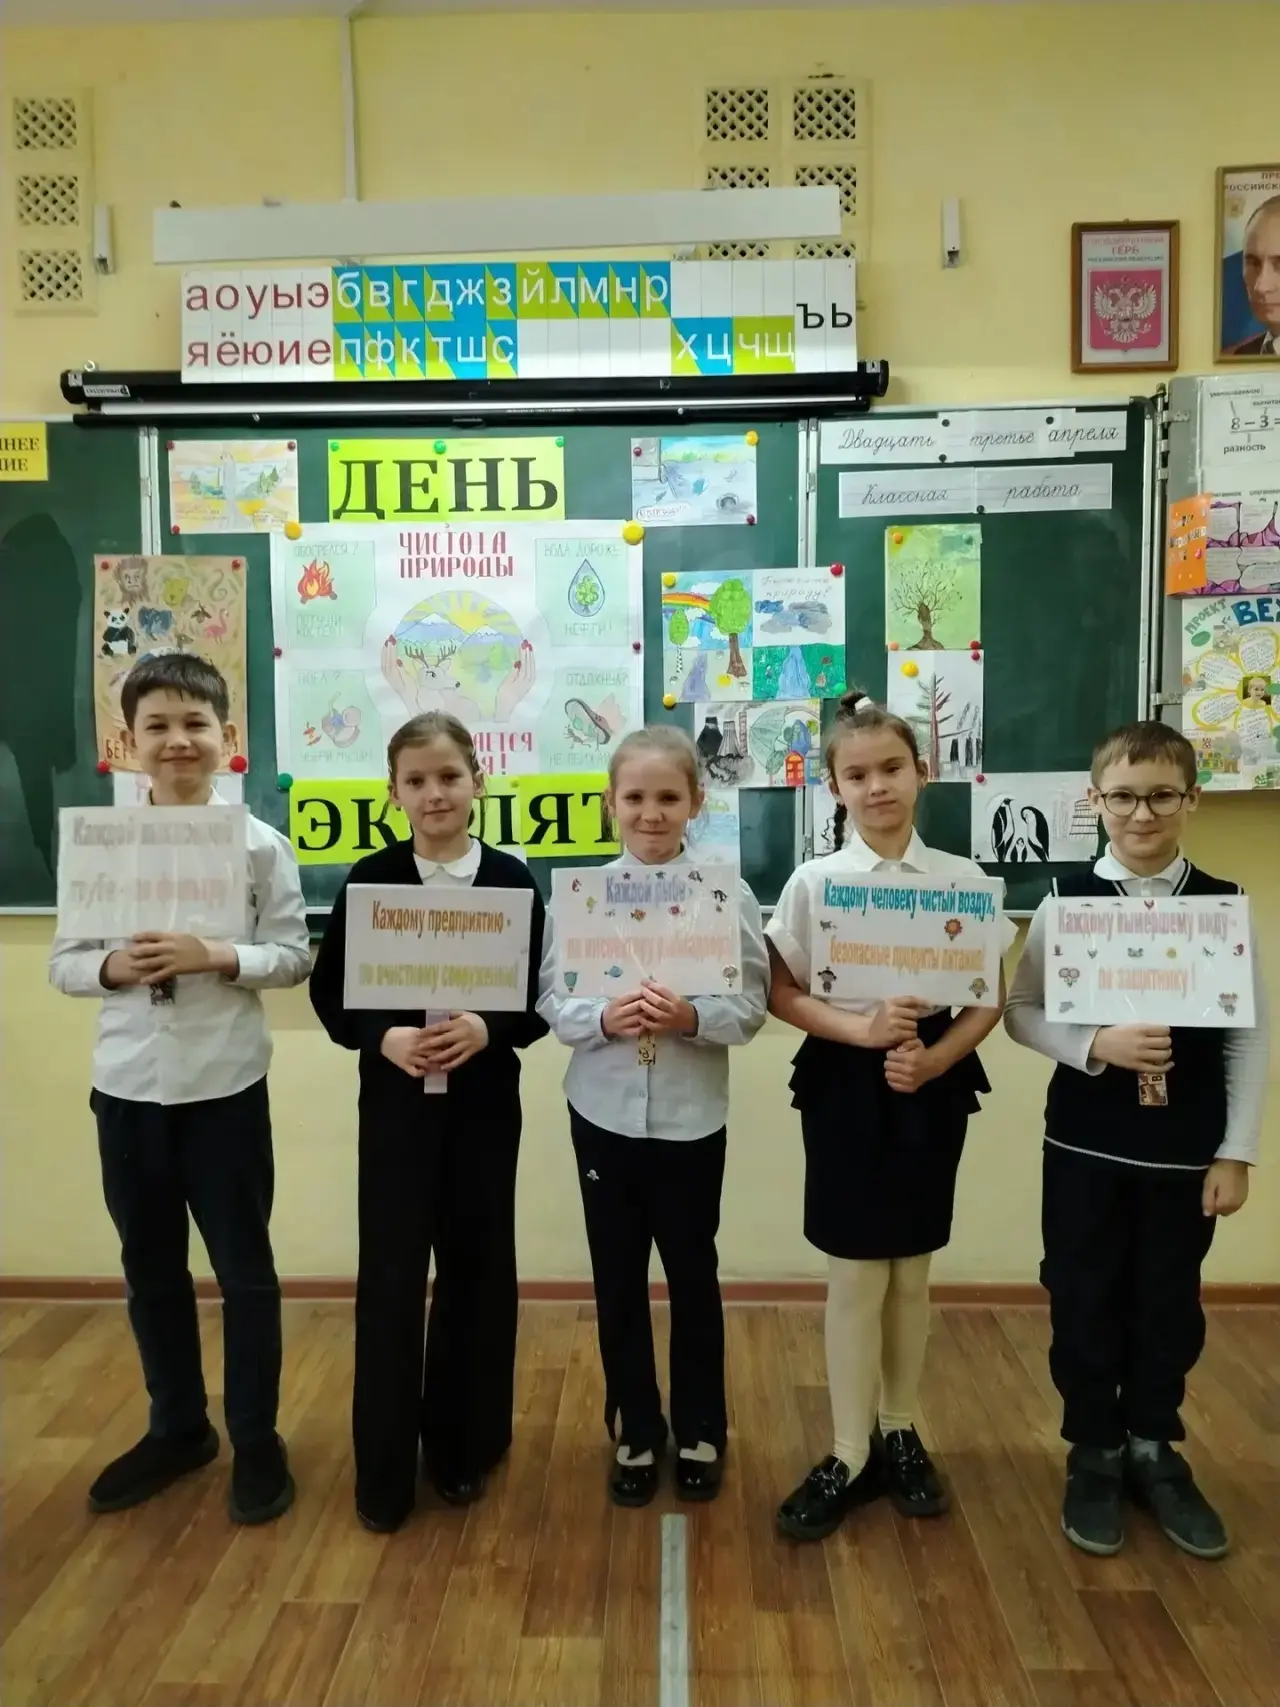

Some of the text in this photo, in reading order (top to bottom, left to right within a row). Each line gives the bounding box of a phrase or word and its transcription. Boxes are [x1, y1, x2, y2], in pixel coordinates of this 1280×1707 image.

[1111, 245, 1139, 255] ГЕРБ
[1230, 416, 1241, 430] 8
[1259, 415, 1269, 429] 3
[838, 425, 1119, 455] Двадцать третье апреля
[1223, 443, 1266, 455] разность
[332, 457, 558, 520] ДЕНЬ
[861, 475, 1082, 508] Классная работа
[399, 531, 508, 556] ЧИСТОТА
[400, 556, 514, 579] ПРИРОДЫ
[1184, 596, 1227, 635] ПРОЕКТ
[606, 875, 650, 906] Каждой
[824, 877, 995, 922] Каждому человеку чистый воздух,
[372, 900, 425, 939] Каждому
[428, 908, 504, 940] предприятию
[1058, 905, 1114, 942] Каждому
